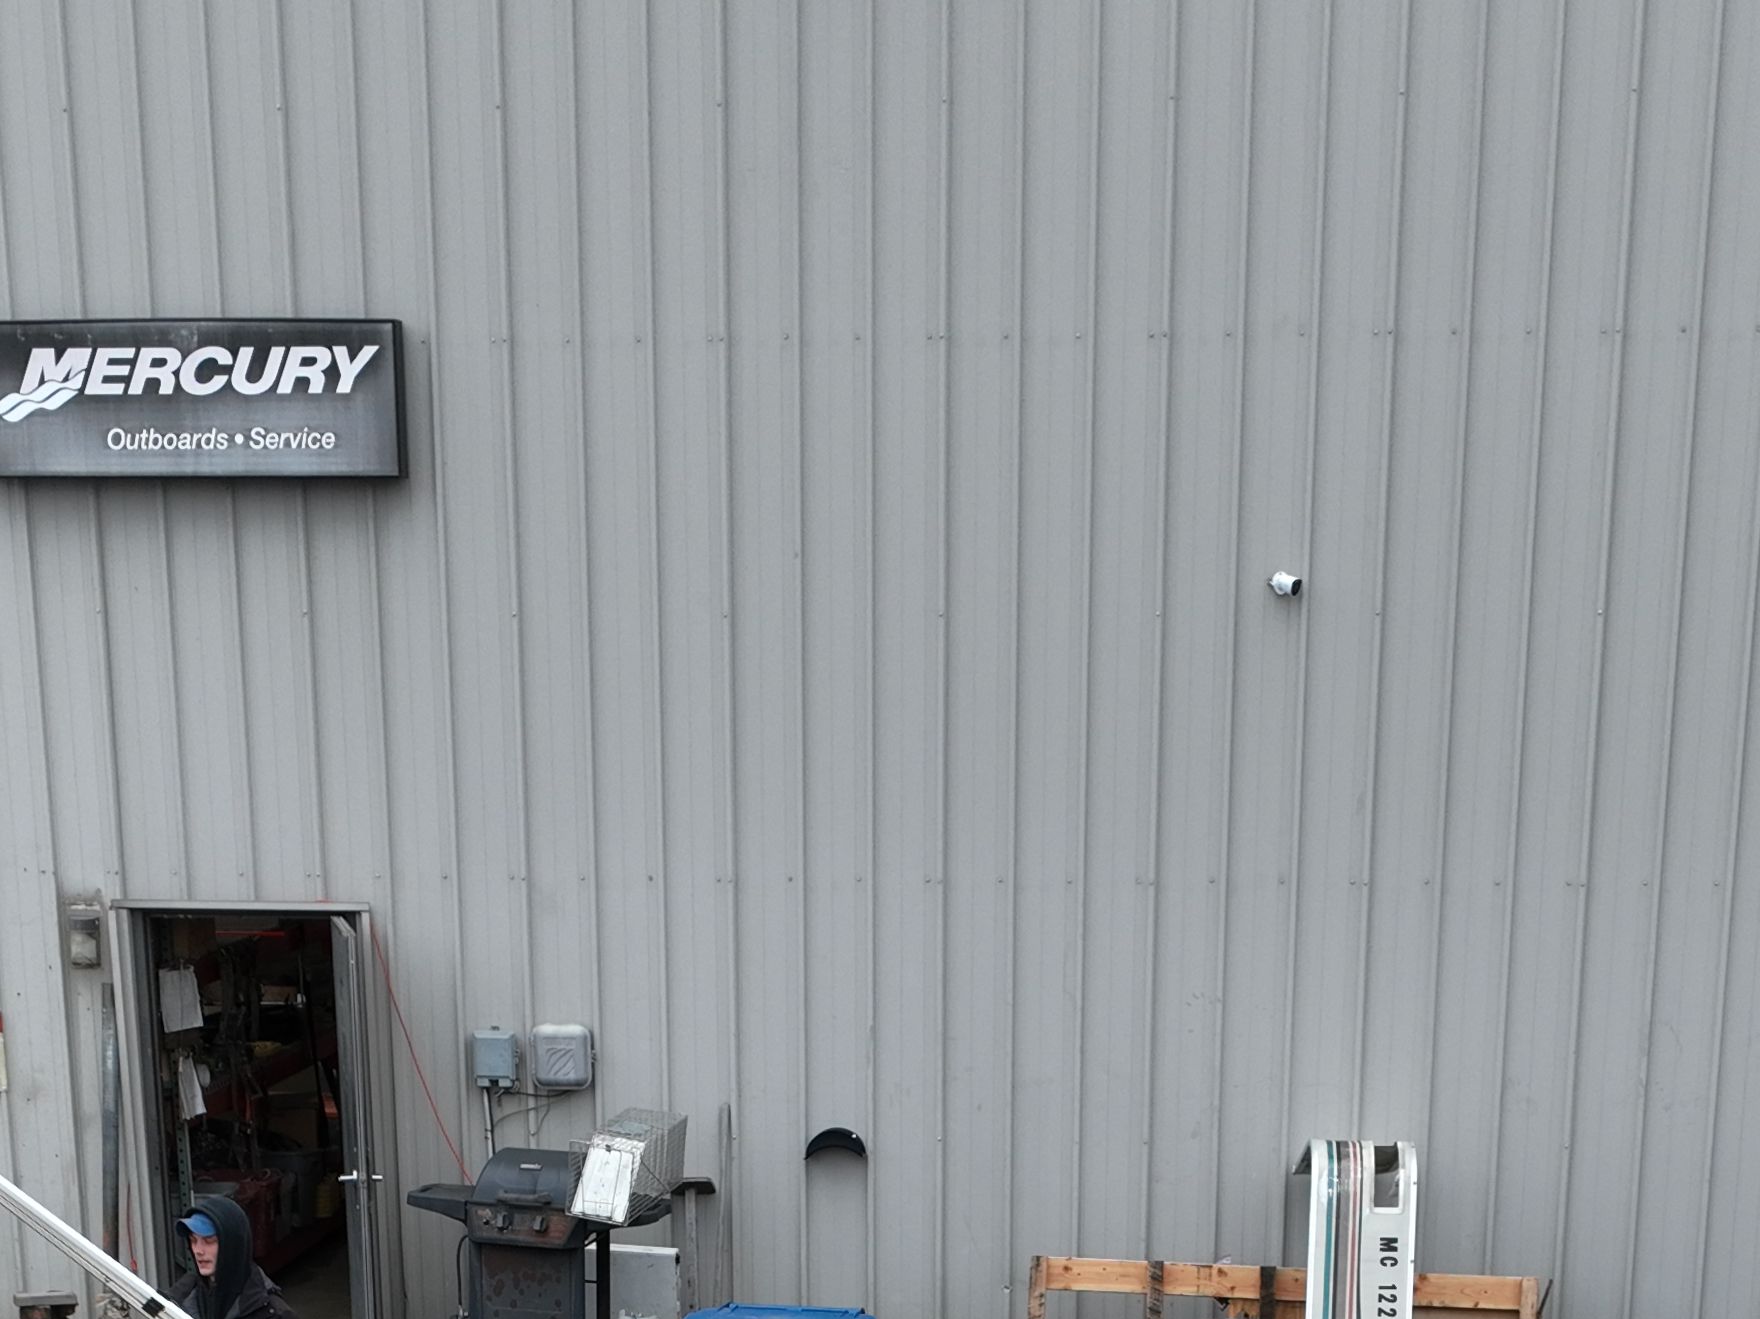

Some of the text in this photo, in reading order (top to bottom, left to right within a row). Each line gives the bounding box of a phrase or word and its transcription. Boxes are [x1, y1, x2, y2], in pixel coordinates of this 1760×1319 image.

[19, 344, 381, 396] MERCURY
[106, 425, 337, 451] Outboards Service
[1379, 1236, 1399, 1268] MC
